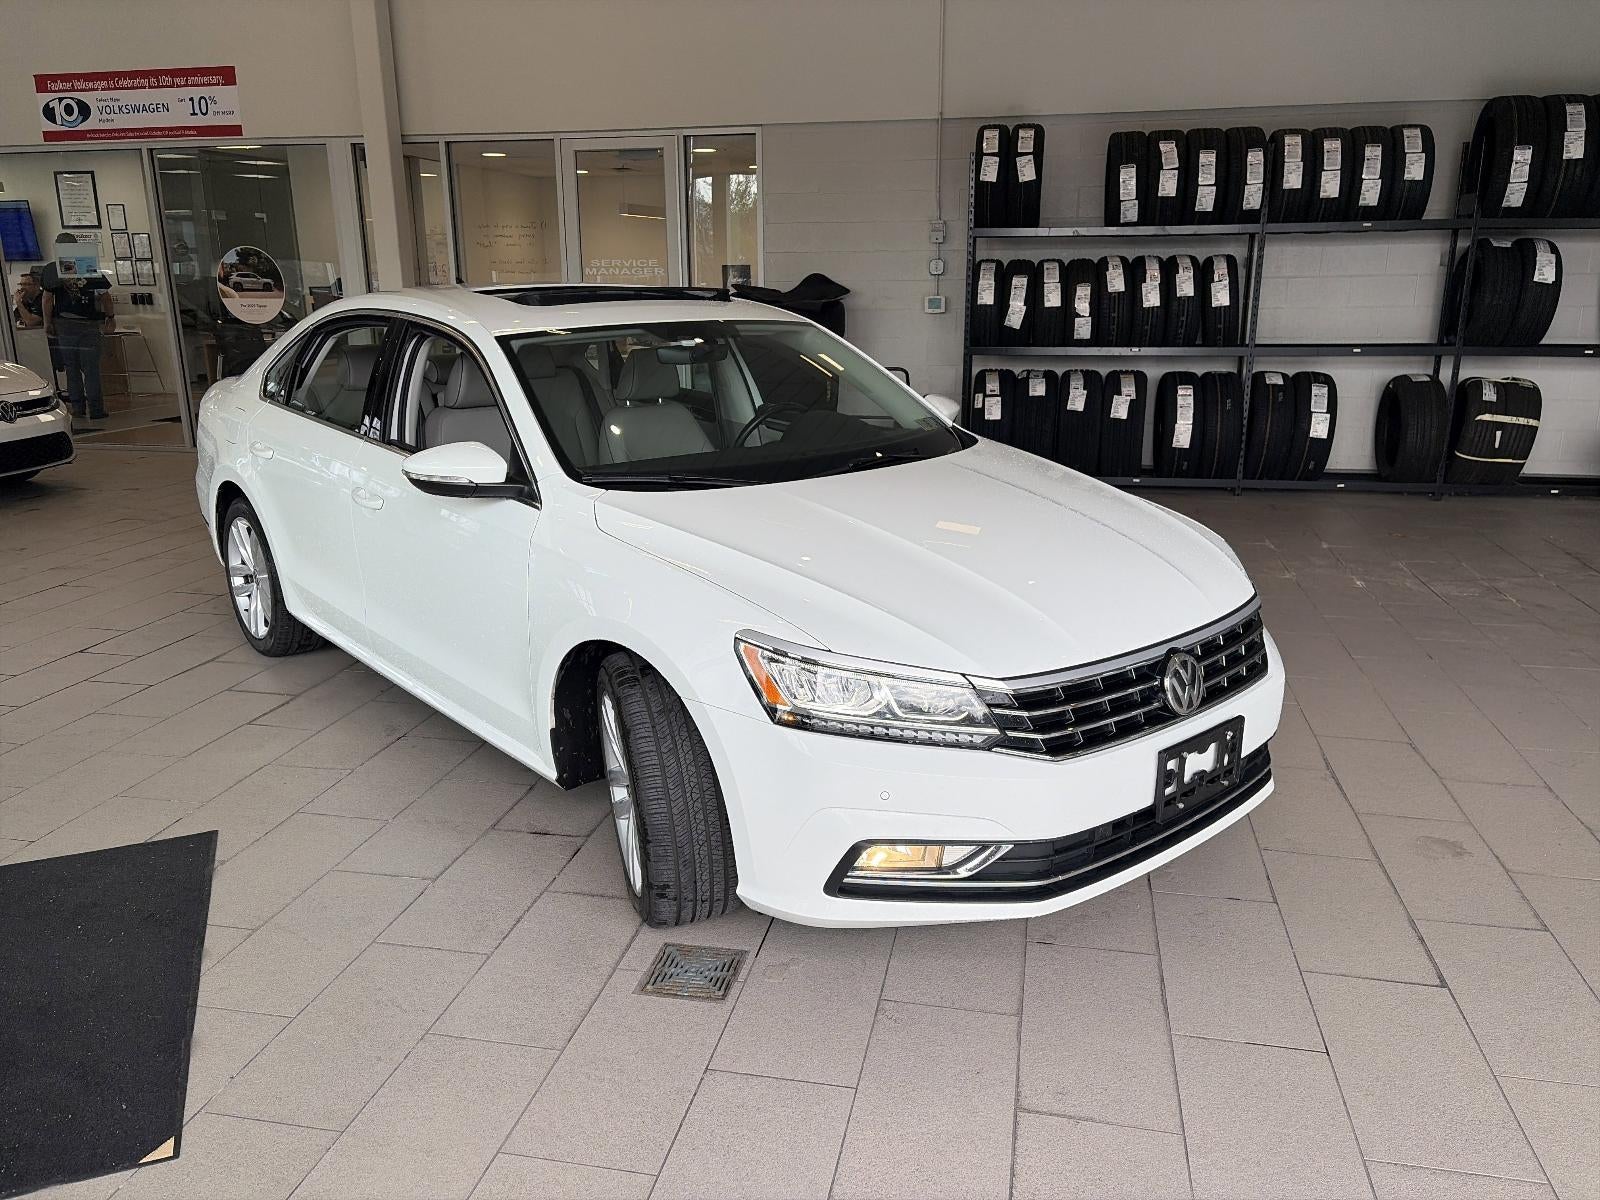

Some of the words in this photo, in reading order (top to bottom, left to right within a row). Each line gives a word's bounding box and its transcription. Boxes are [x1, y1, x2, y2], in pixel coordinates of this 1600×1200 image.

[47, 80, 73, 91] Faulkner
[73, 78, 108, 91] Volkswagen
[109, 78, 115, 88] is
[115, 75, 149, 90] Celebrating
[149, 76, 158, 87] its
[158, 75, 173, 86] 10th
[173, 77, 187, 88] year
[187, 74, 225, 86] anniversary.
[97, 102, 170, 116] VOLKSWAGEN
[590, 259, 659, 267] SERVICE
[585, 267, 665, 276] MANAGER
